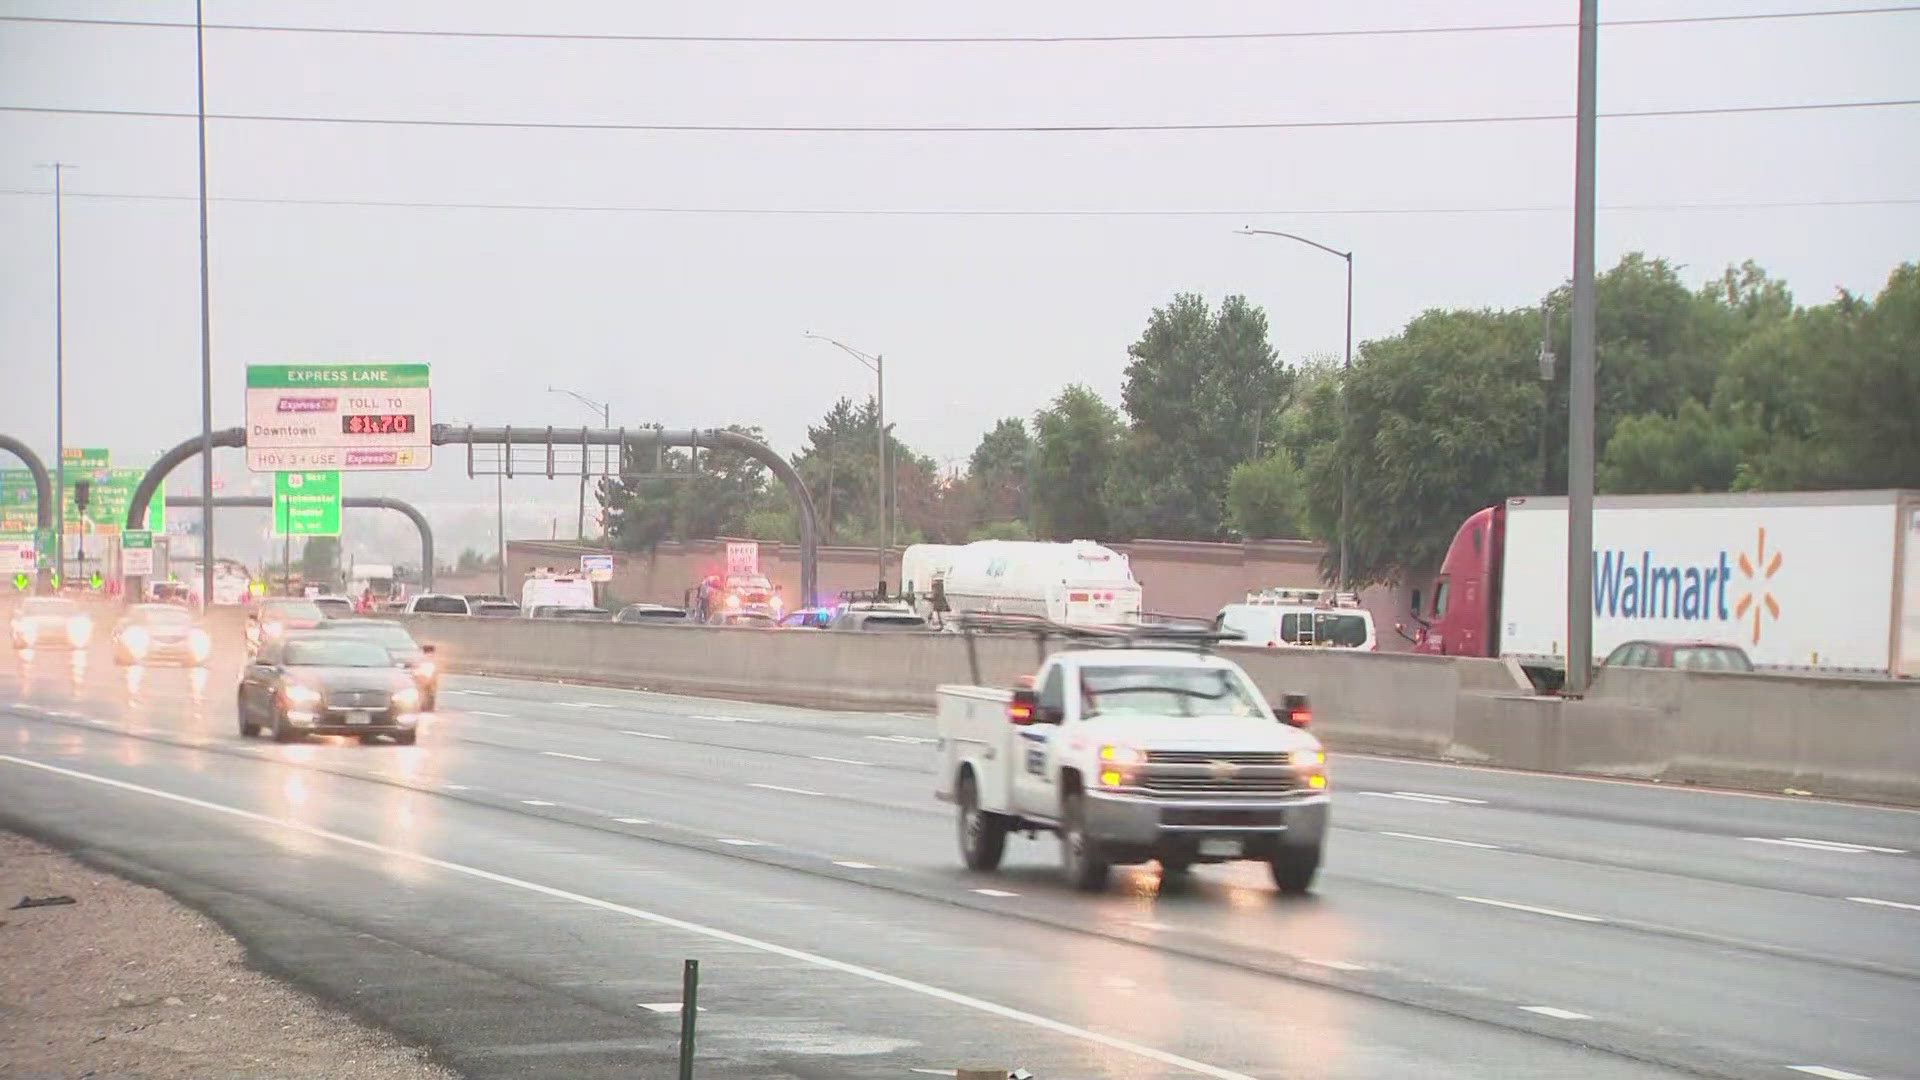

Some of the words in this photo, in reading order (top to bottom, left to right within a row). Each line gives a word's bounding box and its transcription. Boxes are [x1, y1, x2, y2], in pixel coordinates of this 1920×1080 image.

[287, 370, 348, 381] EXPRESS
[352, 370, 388, 381] LANE
[348, 398, 378, 408] TOLL
[388, 398, 402, 408] TO
[349, 416, 407, 432] $1.70
[254, 425, 316, 436] Downtown
[258, 455, 283, 464] HOV
[311, 455, 336, 464] USE
[1592, 550, 1732, 621] Walmart
